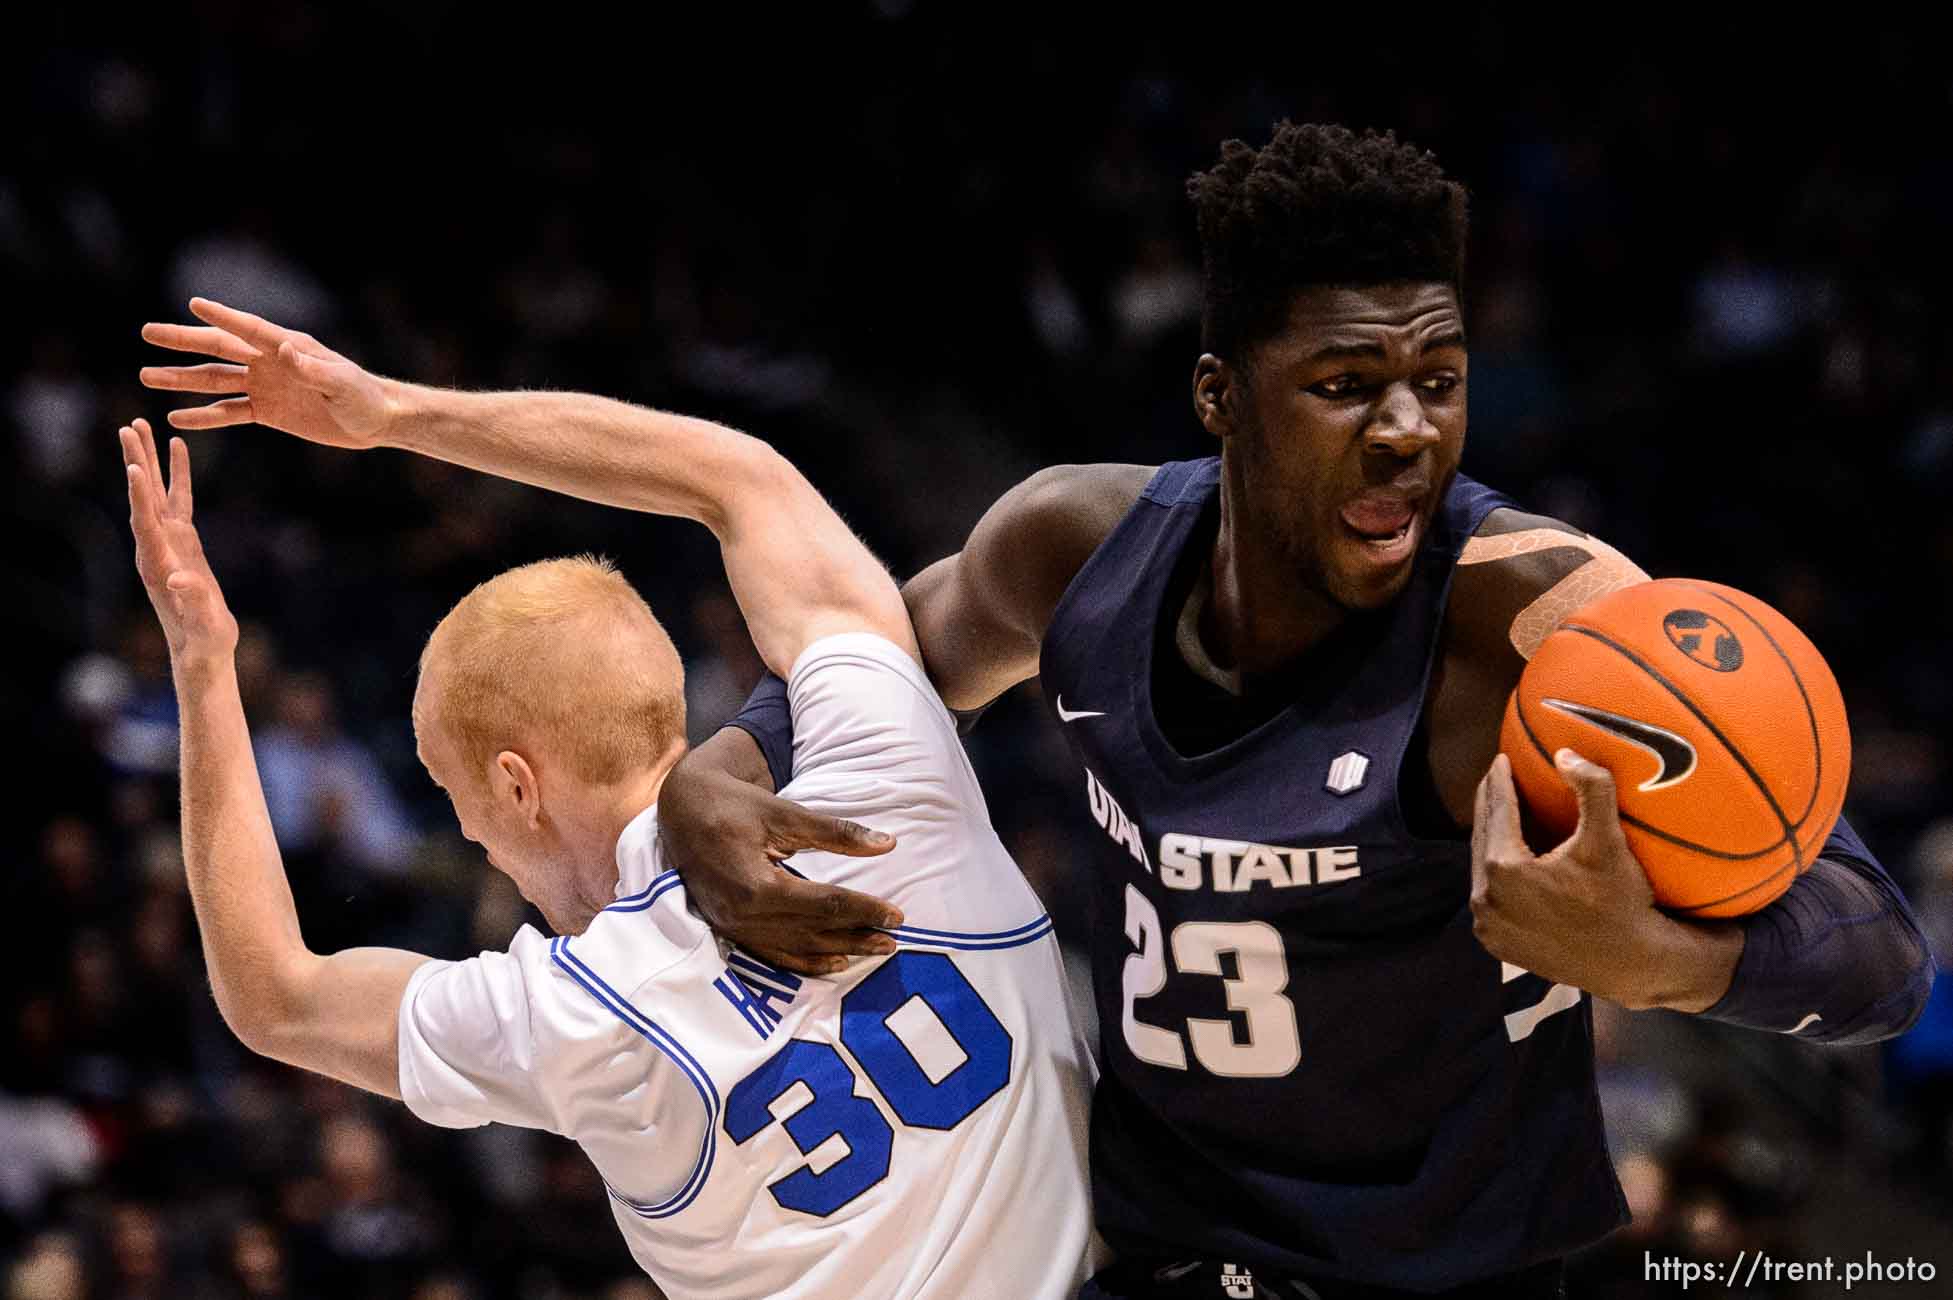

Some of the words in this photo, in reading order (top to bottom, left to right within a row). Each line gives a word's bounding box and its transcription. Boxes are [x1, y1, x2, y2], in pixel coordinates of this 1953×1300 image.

[1160, 832, 1361, 892] STATE
[712, 952, 803, 1041] HA
[1122, 882, 1302, 1078] 23
[722, 949, 1014, 1218] 30
